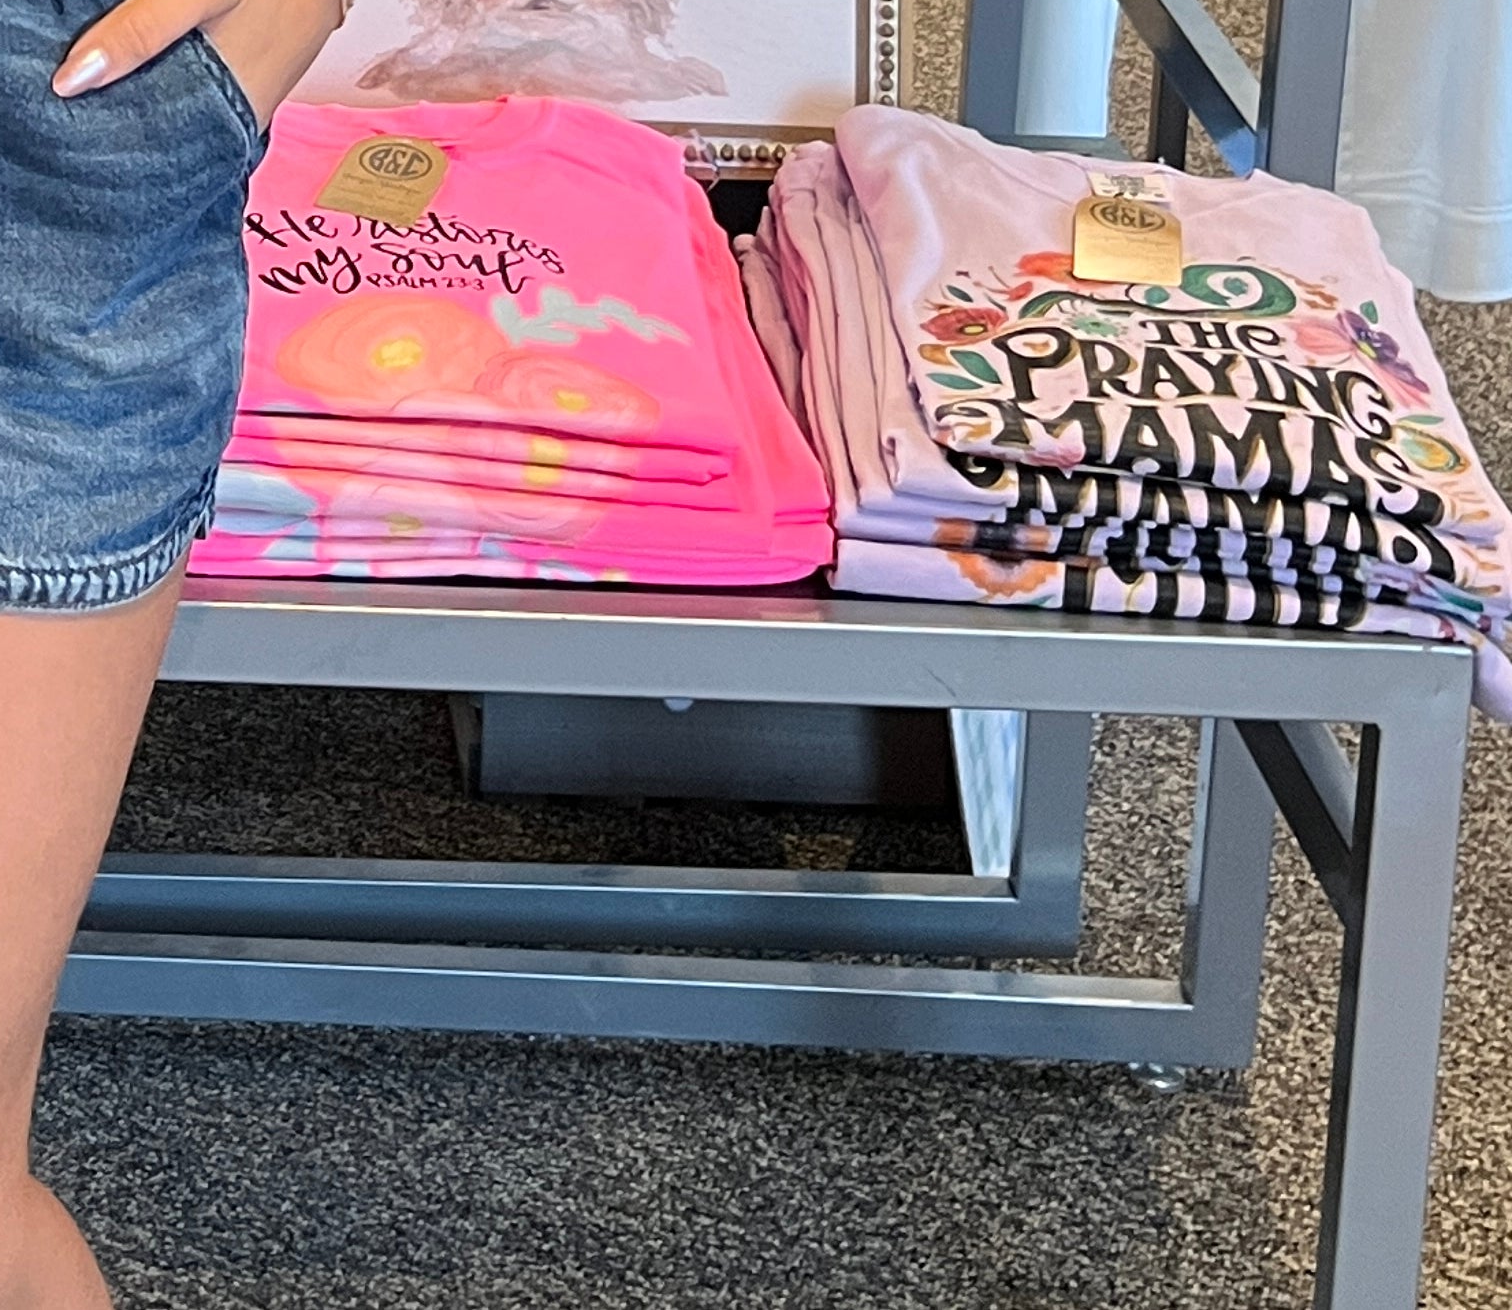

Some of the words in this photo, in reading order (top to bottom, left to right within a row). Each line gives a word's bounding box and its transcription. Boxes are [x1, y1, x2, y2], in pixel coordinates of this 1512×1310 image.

[245, 210, 338, 247] He
[259, 246, 362, 294] my
[370, 242, 536, 294] soul
[366, 274, 438, 289] PSALM
[992, 326, 1394, 441] PRAYING
